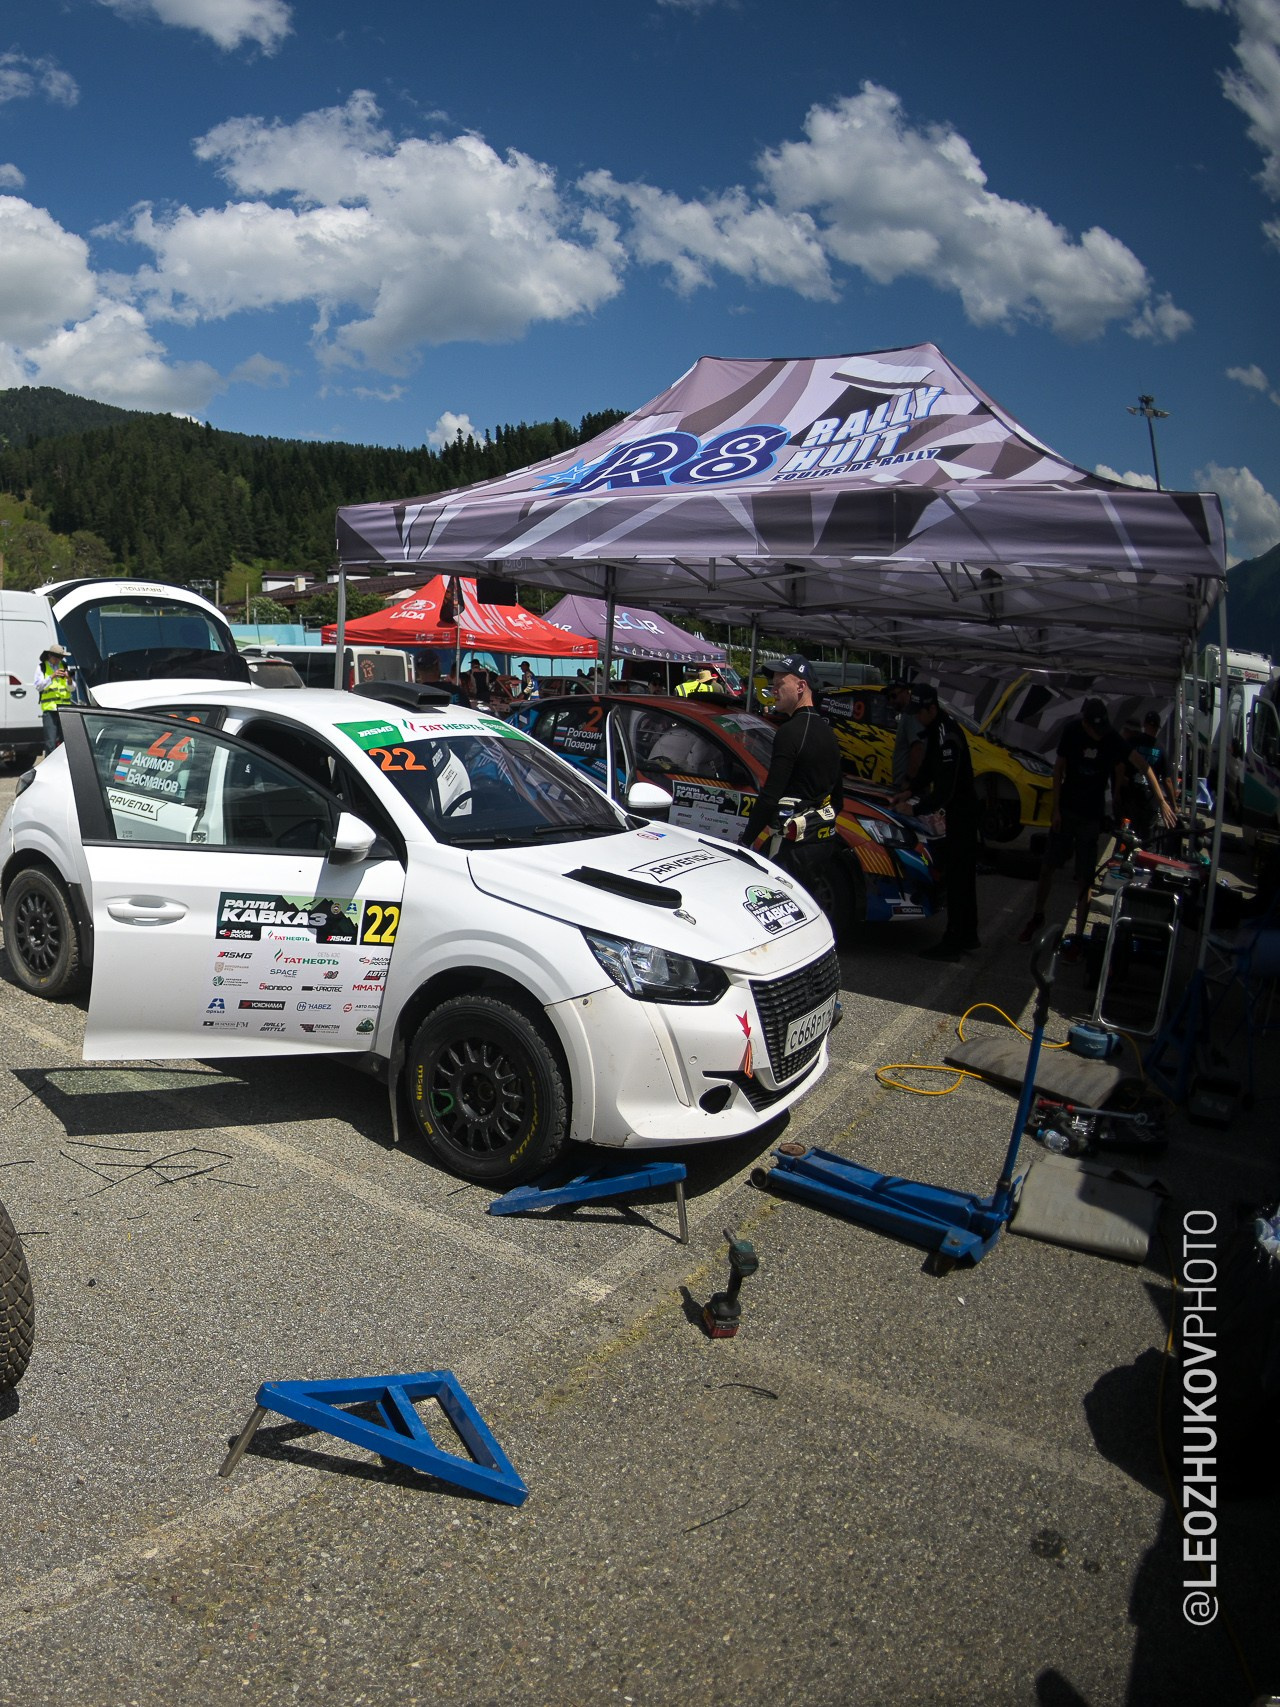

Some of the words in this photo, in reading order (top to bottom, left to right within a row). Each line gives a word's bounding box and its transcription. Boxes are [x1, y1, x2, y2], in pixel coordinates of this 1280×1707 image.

[801, 386, 945, 448] RALLY
[565, 423, 792, 491] R8
[777, 424, 912, 473] HUIT
[770, 464, 848, 483] EQUIPE
[848, 460, 875, 473] DE
[880, 448, 942, 466] RALLY
[389, 610, 425, 621] LADA
[419, 723, 485, 732] ТАТНЕФТЬ
[567, 727, 603, 740] Рогозин
[564, 738, 597, 752] Позерн
[132, 752, 175, 773] Акимов
[368, 747, 427, 771] 22
[126, 768, 179, 794] Басманов
[676, 785, 700, 793] РАЛЛИ
[110, 794, 154, 814] RAVENOL
[675, 790, 725, 805] КАВКАЗ
[224, 899, 276, 910] РАЛЛИ
[757, 900, 800, 925] КАВКАЗ
[221, 908, 328, 927] КАВКАЗ
[363, 905, 400, 943] 22
[283, 957, 339, 965] ТАТНЕФТЬ
[269, 968, 298, 976] SPACE
[251, 1001, 283, 1009] YOKOHAMA
